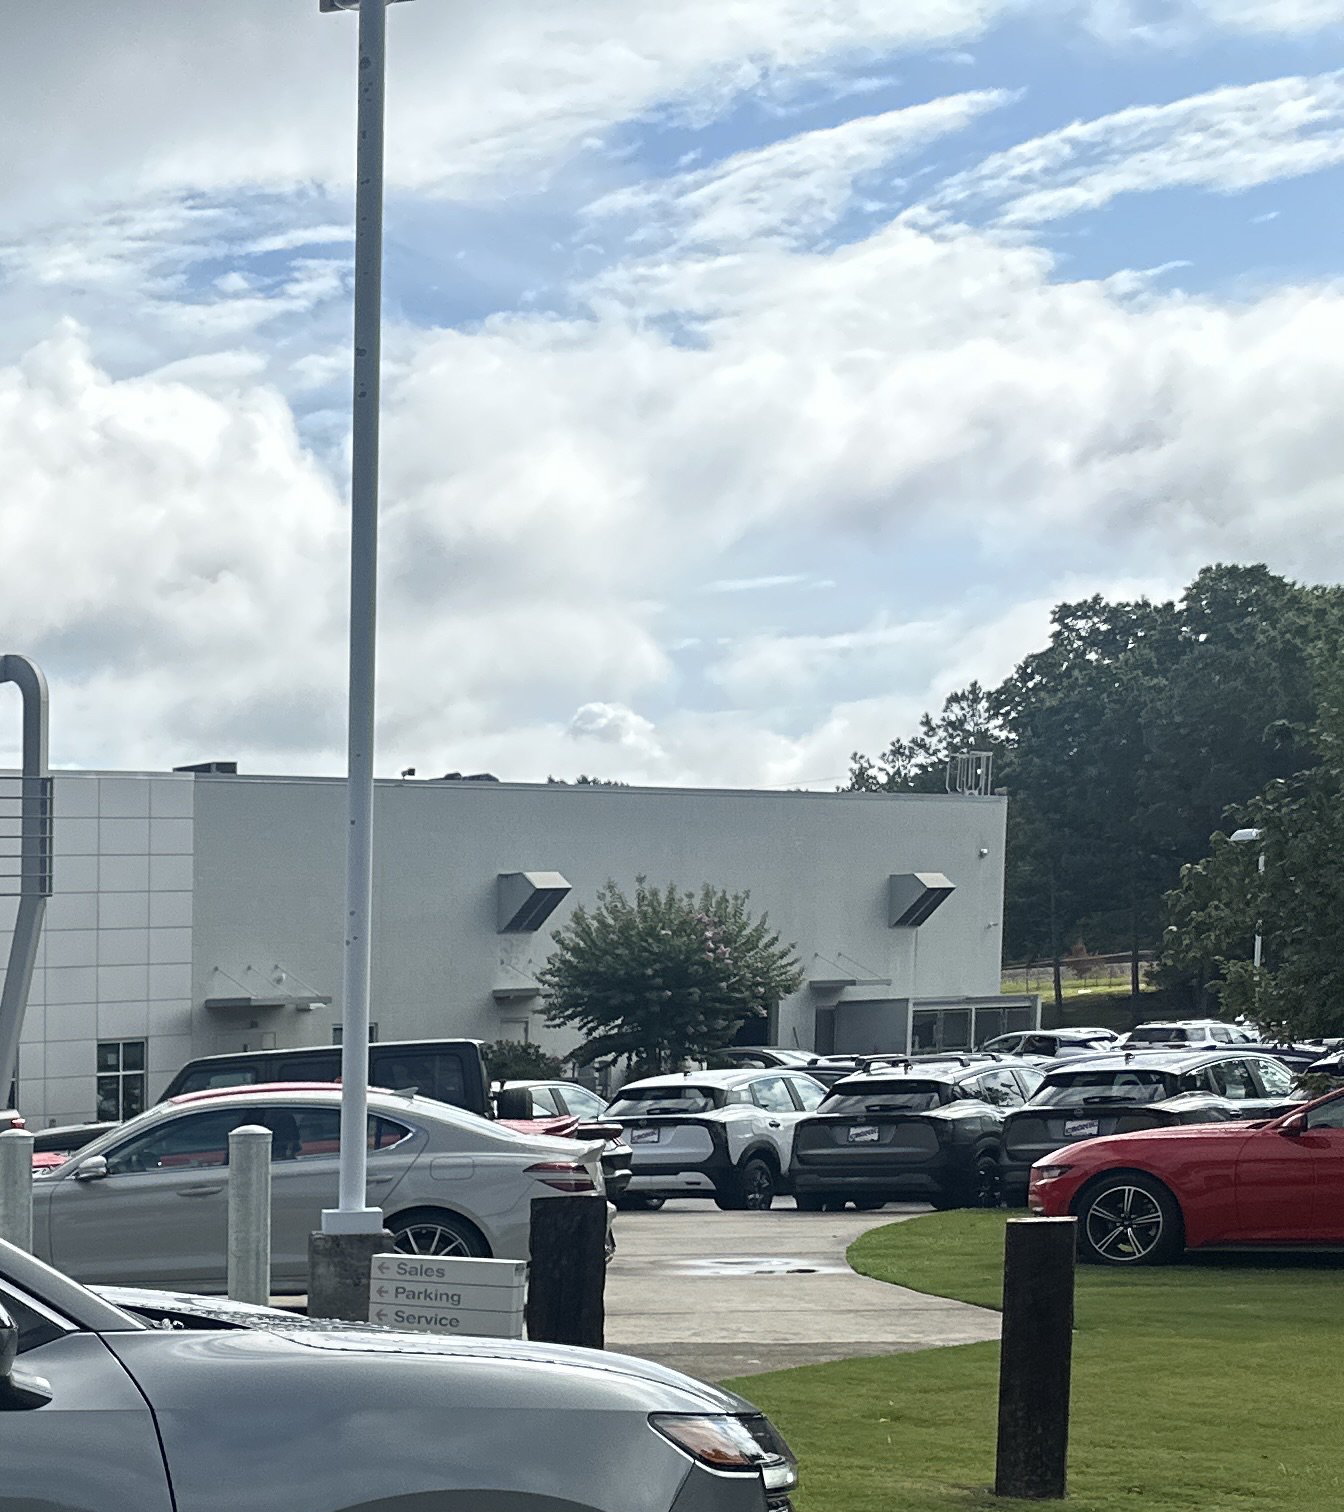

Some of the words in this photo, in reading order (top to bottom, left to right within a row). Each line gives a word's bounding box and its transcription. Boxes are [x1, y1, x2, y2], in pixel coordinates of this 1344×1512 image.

[396, 1262, 445, 1278] Sales
[394, 1286, 461, 1306] Parking
[394, 1310, 460, 1328] Service
